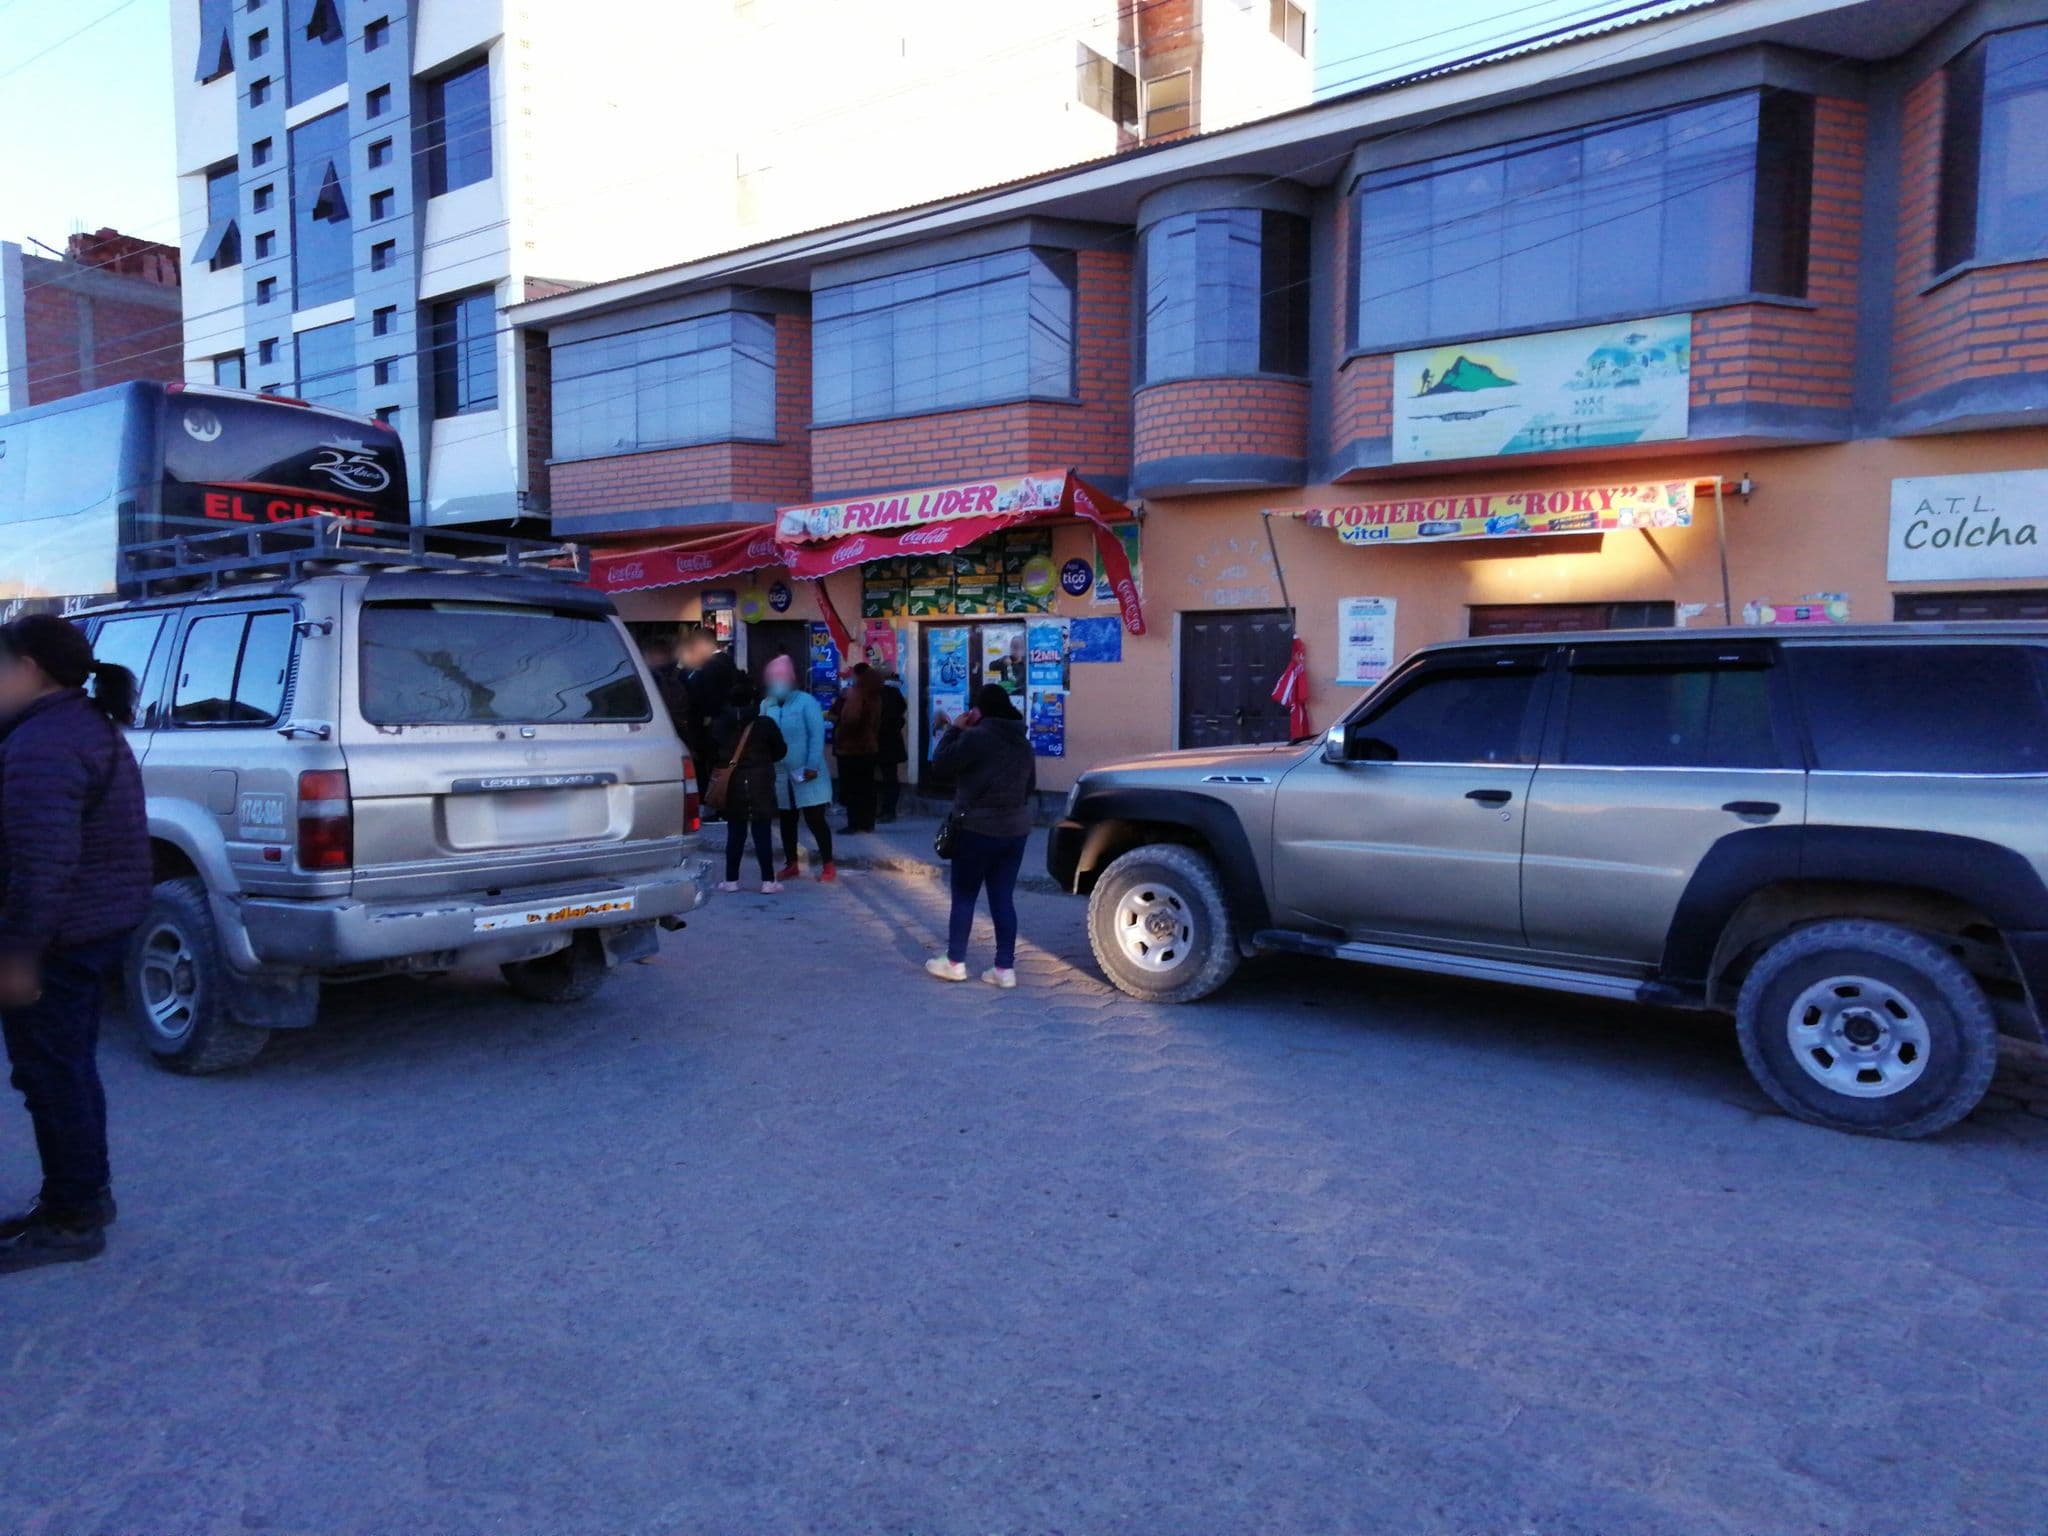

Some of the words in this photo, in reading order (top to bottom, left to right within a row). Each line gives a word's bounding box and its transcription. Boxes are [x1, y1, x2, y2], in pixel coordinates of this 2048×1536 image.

[309, 451, 390, 492] 25
[204, 492, 256, 522] EL
[842, 496, 912, 529] FRIAL
[917, 484, 998, 519] LIDER
[1327, 495, 1498, 529] COMERCIAL
[1341, 525, 1389, 541] vital
[1904, 516, 2038, 550] Colcha
[480, 778, 530, 789] LEXUS
